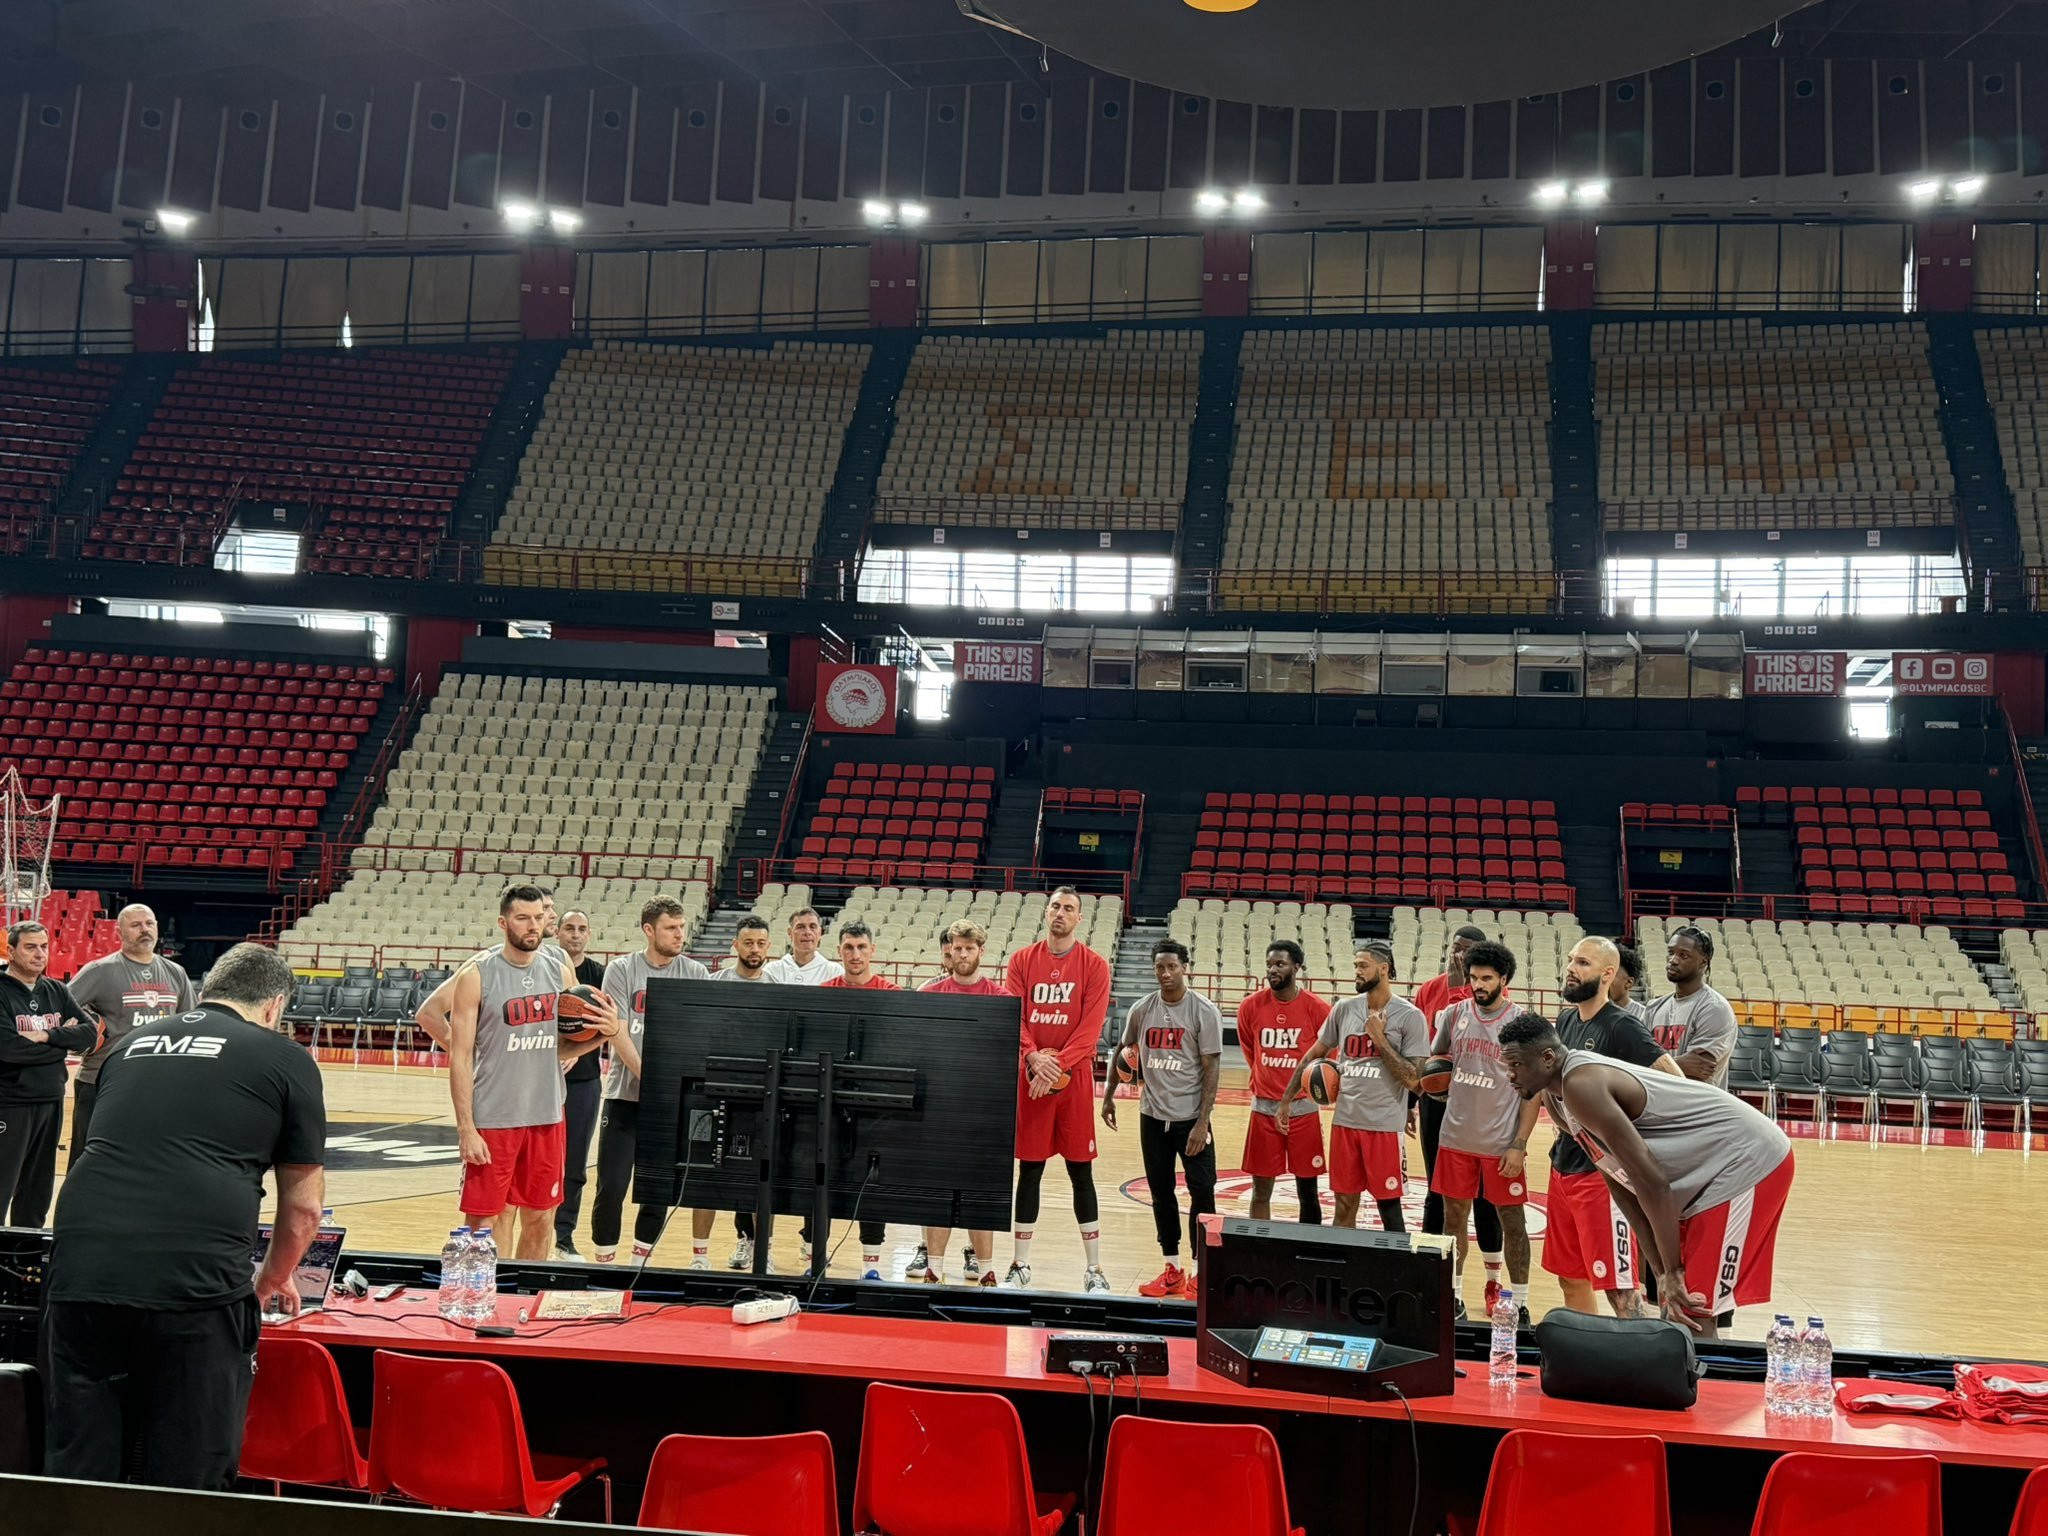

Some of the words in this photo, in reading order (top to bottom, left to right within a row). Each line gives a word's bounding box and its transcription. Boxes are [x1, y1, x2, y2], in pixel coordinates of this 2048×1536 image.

[965, 645, 1001, 663] THIS
[1018, 647, 1033, 664] IS
[1755, 655, 1796, 673] THIS
[1816, 655, 1834, 673] IS
[1900, 684, 1987, 693] @OLYMPIACOSBC
[1031, 982, 1075, 1004] OLY
[503, 993, 557, 1026] OLY
[1030, 1009, 1068, 1025] bwin
[125, 1035, 227, 1057] FMS
[507, 1030, 554, 1052] bwin
[1146, 1028, 1185, 1050] OLY
[1260, 1028, 1302, 1049] OLY
[1147, 1055, 1181, 1071] bwin
[1261, 1052, 1297, 1068] bwin
[1344, 1060, 1380, 1079] bwin
[1453, 1068, 1494, 1089] bwin
[1616, 1220, 1629, 1273] GSA
[1719, 1245, 1739, 1299] GSA
[1222, 1274, 1421, 1328] molten
